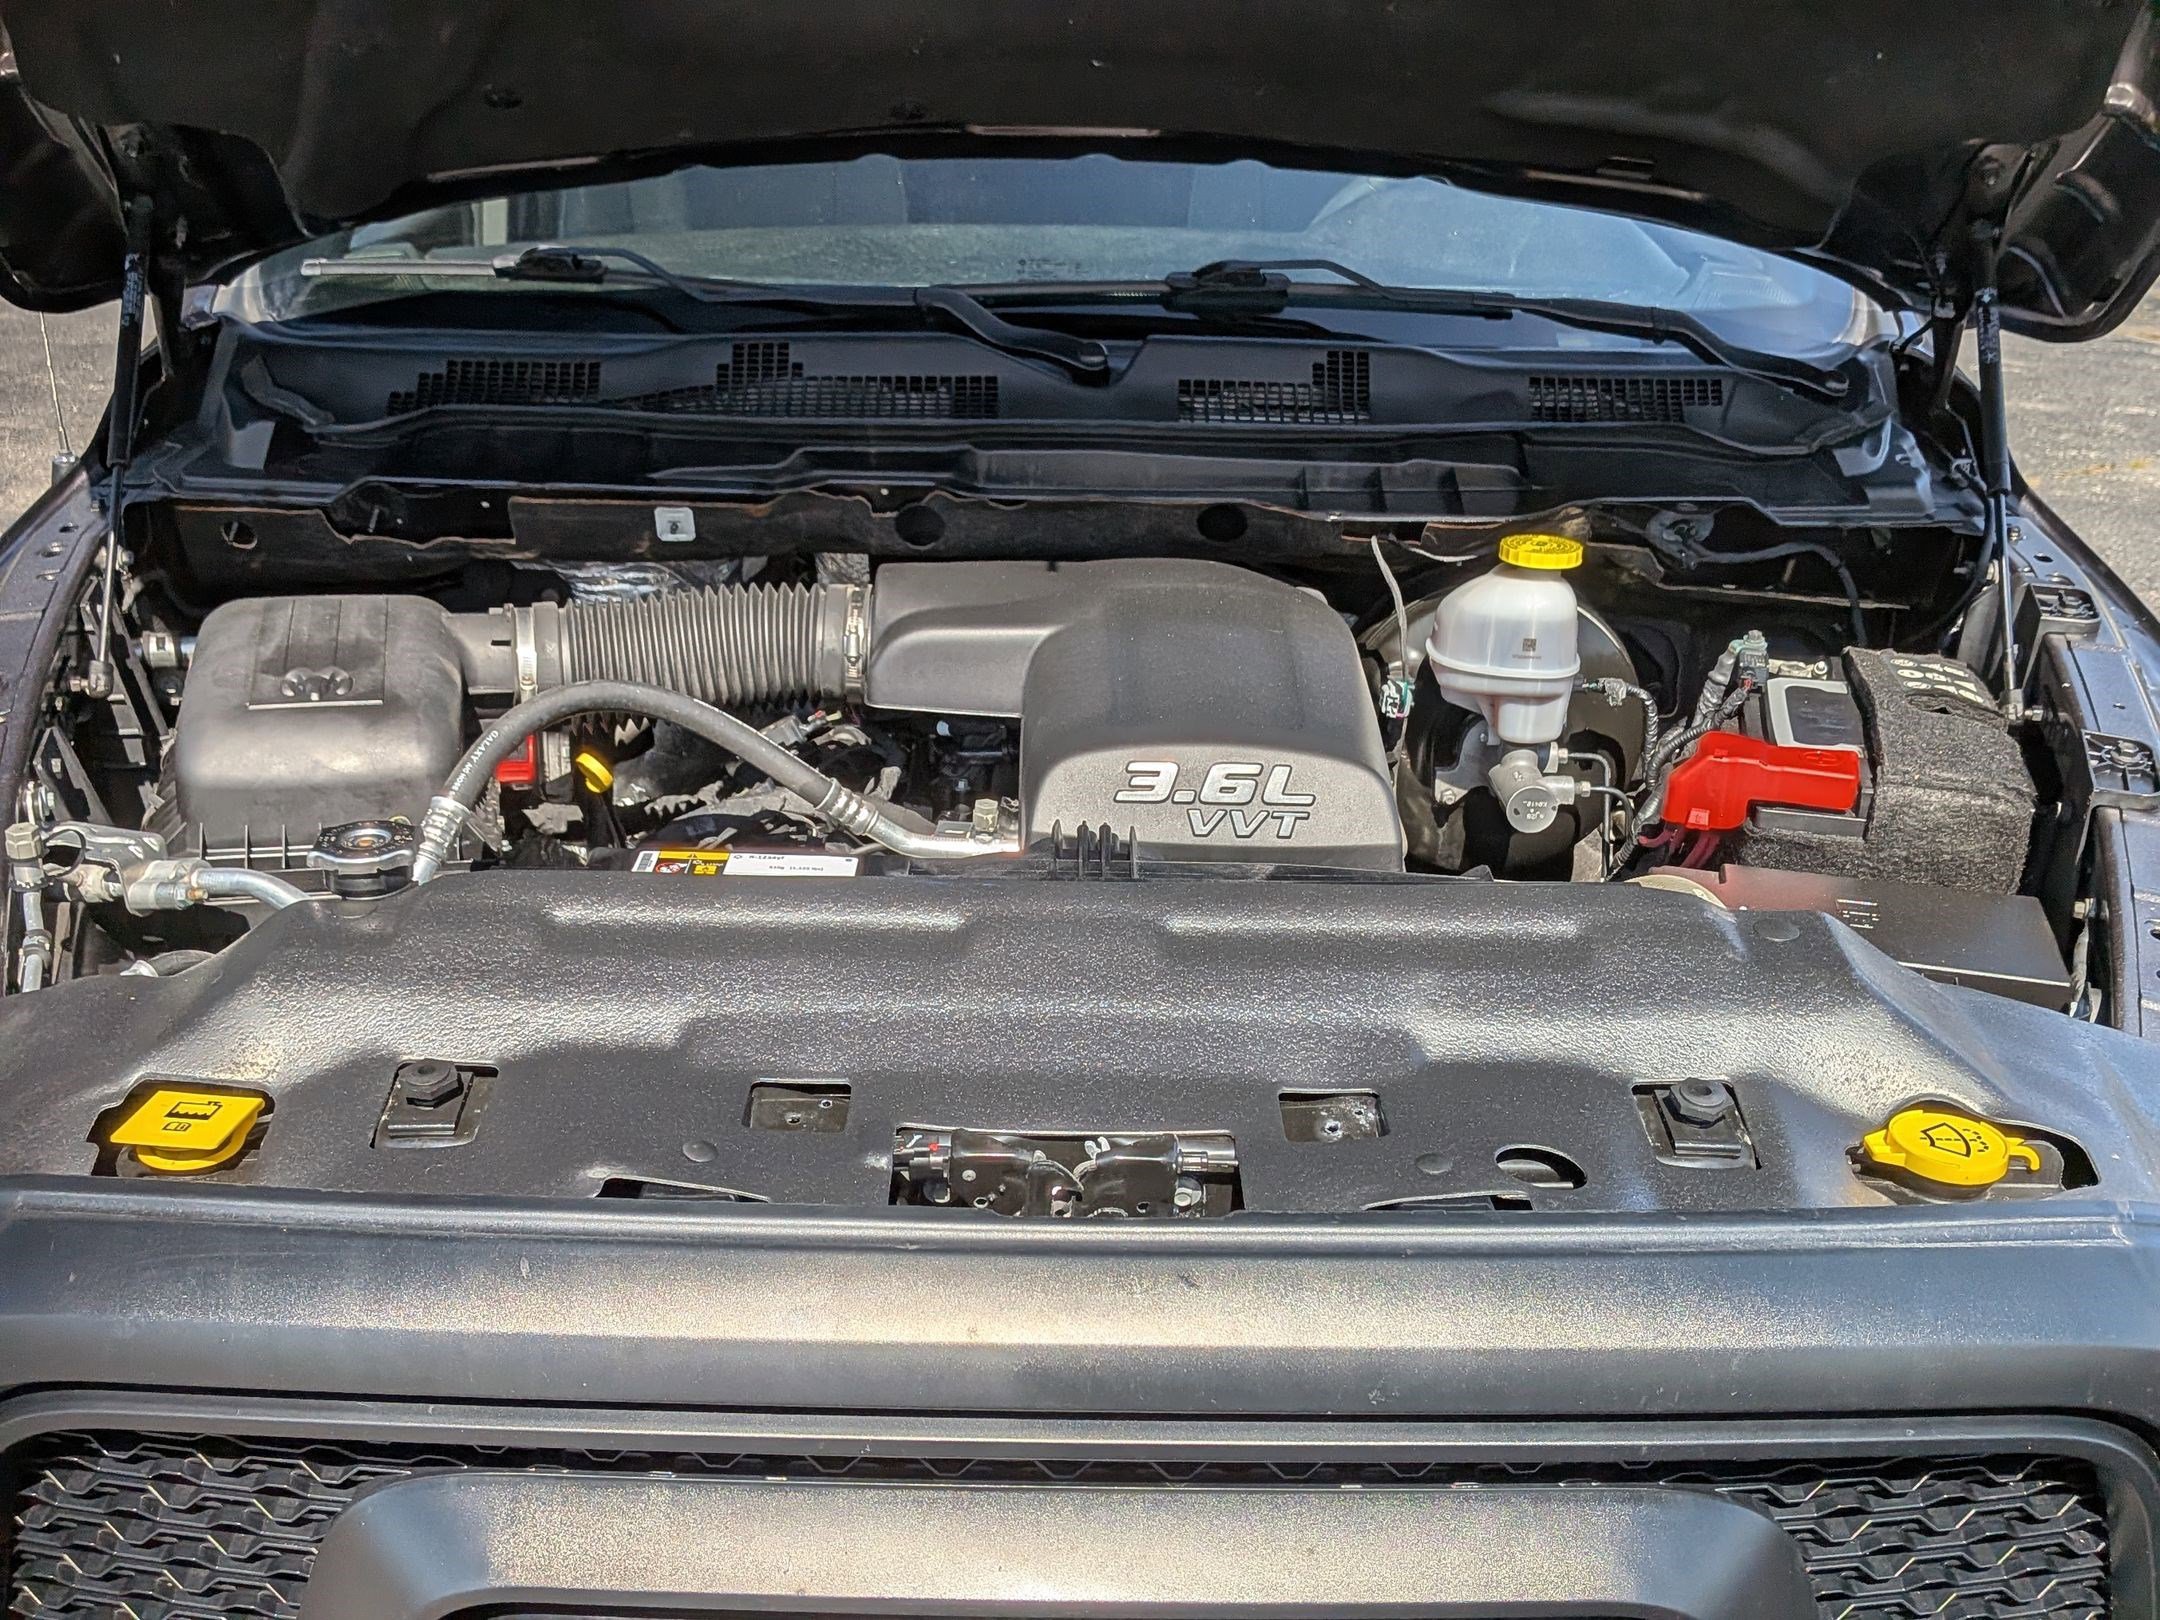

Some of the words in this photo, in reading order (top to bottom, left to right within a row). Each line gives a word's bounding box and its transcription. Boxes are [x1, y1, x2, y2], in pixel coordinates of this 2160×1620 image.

[470, 730, 499, 763] GALAXY
[1113, 761, 1316, 806] 3.6L
[1186, 808, 1310, 840] VVT
